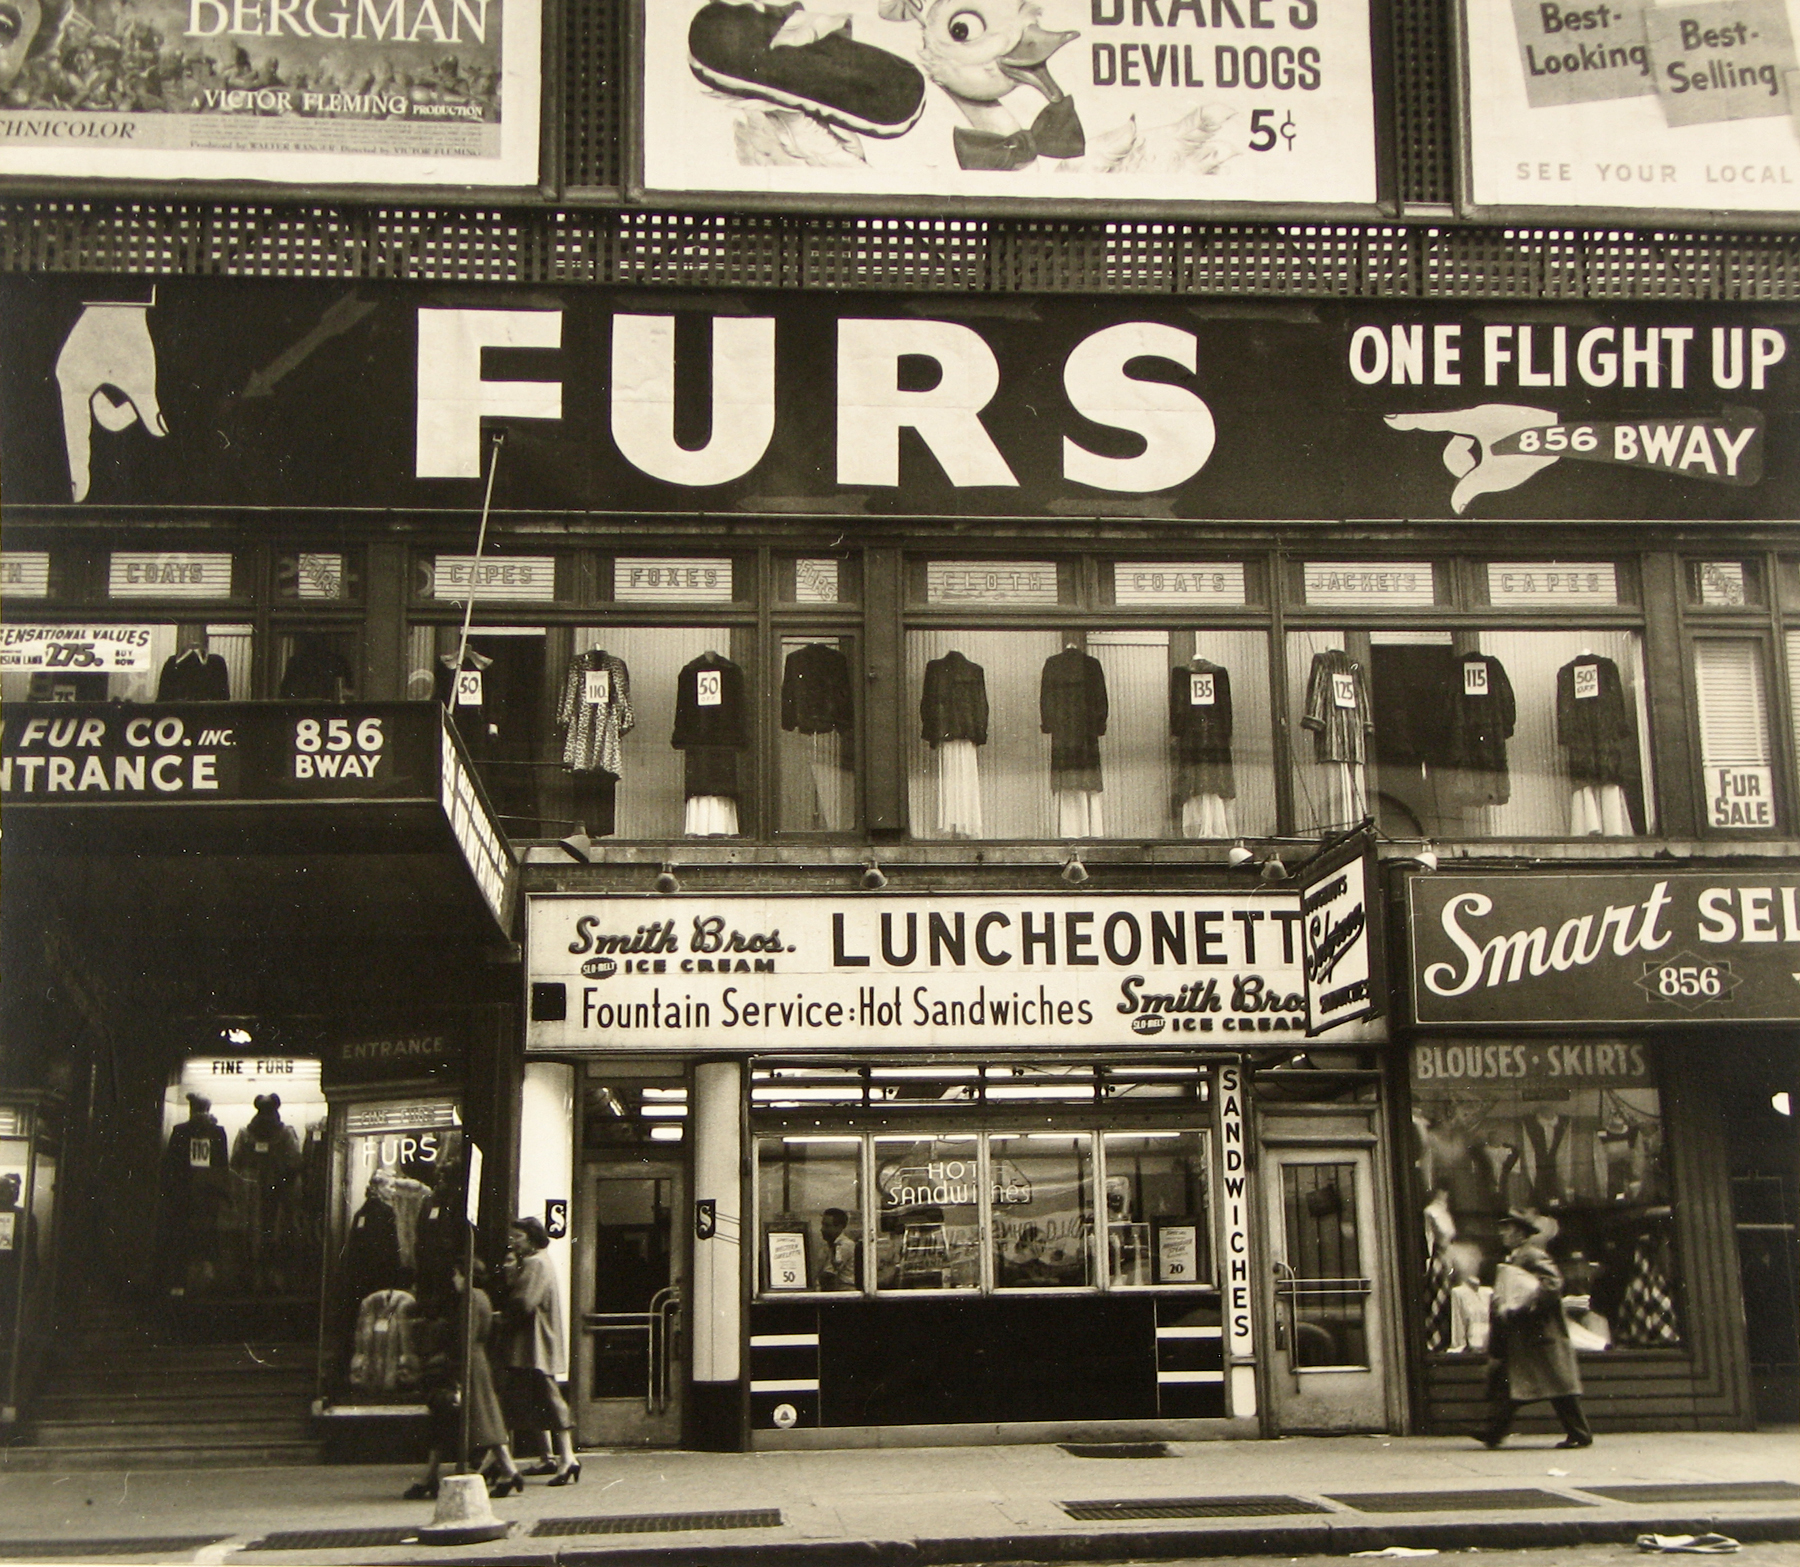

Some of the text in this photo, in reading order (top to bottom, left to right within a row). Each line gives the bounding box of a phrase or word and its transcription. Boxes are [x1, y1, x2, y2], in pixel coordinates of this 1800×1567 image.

[1539, 2, 1622, 34] Best-
[1679, 19, 1760, 51] Best-
[1092, 43, 1321, 91] DEVIL DOGS
[1525, 43, 1650, 76] Looking
[1666, 60, 1779, 96] Selling
[203, 89, 293, 111] VICTOR
[303, 93, 408, 115] FLEMING
[412, 104, 483, 117] PRODUCTION
[1516, 162, 1794, 184] SEE YOUR LOCAL
[1349, 325, 1786, 390] ONE FLIGHT UP
[416, 307, 1216, 493] FURS
[1518, 424, 1756, 476] 856 BWAY
[127, 563, 203, 583] COATS
[300, 553, 341, 599] FURS
[450, 564, 532, 585] CAPES
[629, 567, 718, 588] FOXES
[797, 558, 837, 601] FURS
[942, 571, 1041, 591] CLOTH
[1134, 573, 1225, 592] COATS
[1311, 572, 1417, 592] JACKETS
[1501, 573, 1600, 592] CAPES
[92, 630, 151, 647] VALUES
[1193, 680, 1213, 698] 135
[1335, 680, 1353, 700] 125
[1466, 669, 1486, 688] 115
[19, 717, 106, 747] FUR
[125, 717, 192, 748] CO.
[198, 729, 237, 746] INC.
[295, 718, 385, 752] 856
[294, 754, 382, 779] BWAY
[1718, 768, 1762, 798] FUR
[1714, 796, 1770, 827] SALE
[568, 914, 797, 955] Smith Bros.
[832, 910, 1303, 967] LUNCHEONETT
[1423, 881, 1673, 997] Smart
[625, 958, 776, 974] ICE CREAM
[1658, 966, 1721, 996] 856
[582, 986, 711, 1030] Fountain
[913, 984, 1094, 1027] Sandwiches
[1117, 974, 1222, 1014] Smith
[1172, 1017, 1213, 1031] ICE
[342, 1036, 443, 1059] ENTRANCE
[1415, 1043, 1646, 1079] BLOUSES SKIRTS
[212, 1060, 244, 1075] FINE
[363, 1135, 438, 1168] FURS
[928, 1160, 979, 1180] HOT
[1222, 1069, 1250, 1338] SANDWICHES
[783, 1270, 795, 1283] 50
